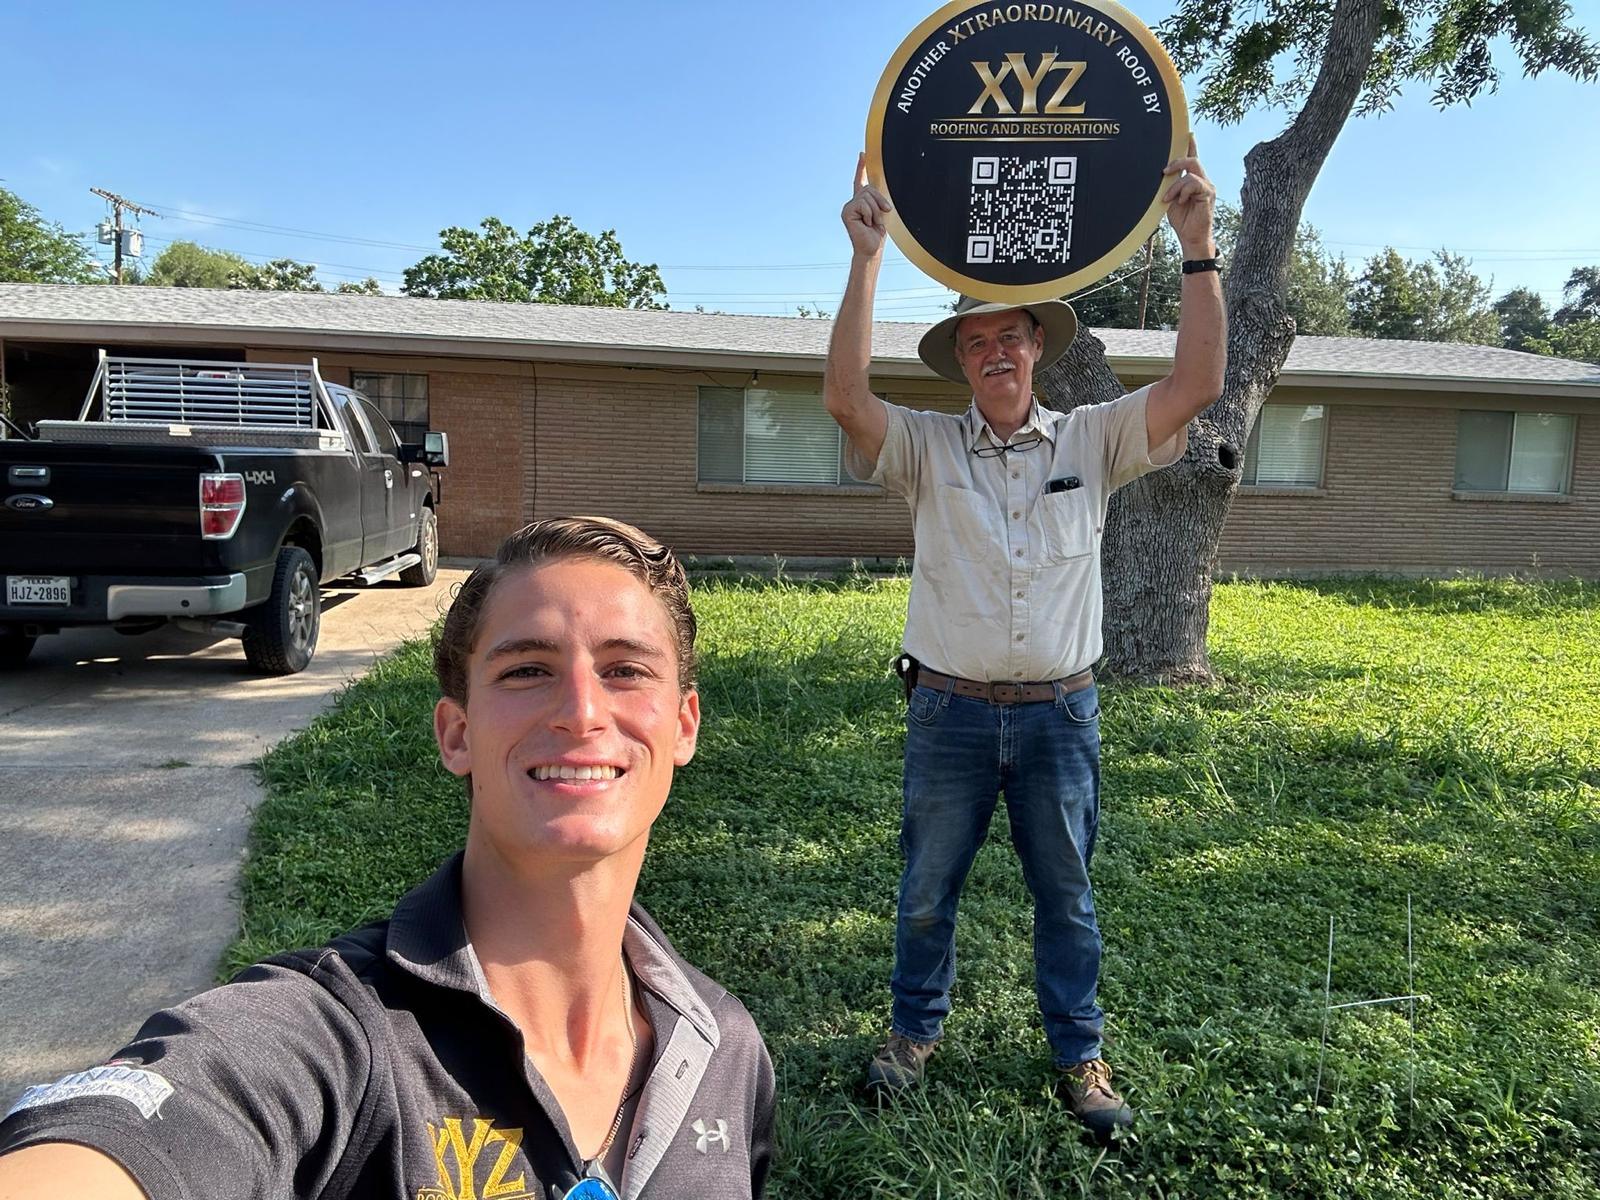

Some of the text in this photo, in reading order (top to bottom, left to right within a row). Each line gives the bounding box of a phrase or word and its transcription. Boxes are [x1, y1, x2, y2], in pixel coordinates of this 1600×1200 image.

[897, 3, 1162, 115] ANOTHER XTRAORDINARY ROOF BY
[967, 52, 1088, 115] XYZ
[929, 123, 1121, 136] ROOFING AND RESTORATIONS
[426, 1116, 526, 1200] XYZ
